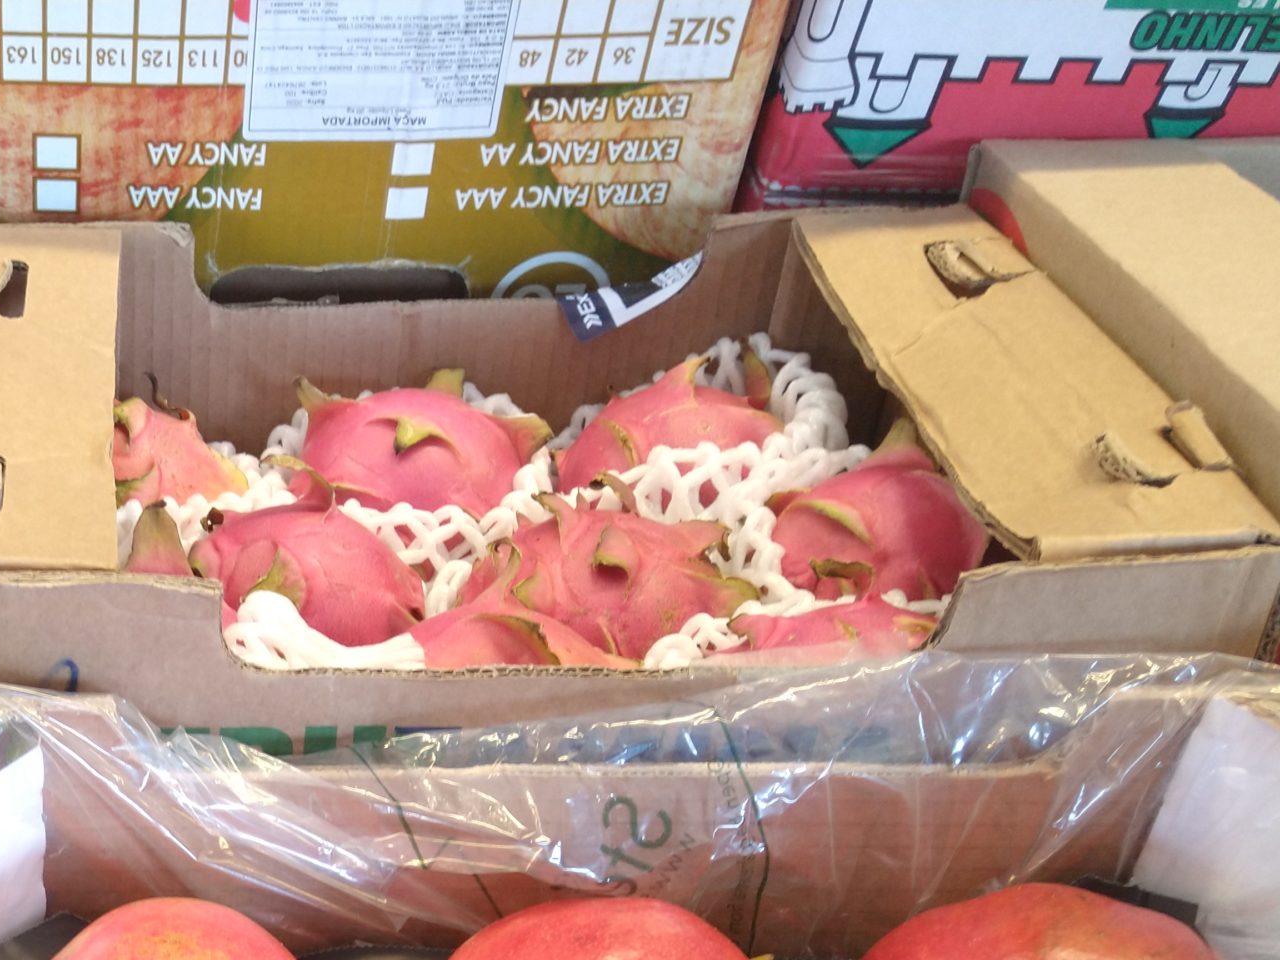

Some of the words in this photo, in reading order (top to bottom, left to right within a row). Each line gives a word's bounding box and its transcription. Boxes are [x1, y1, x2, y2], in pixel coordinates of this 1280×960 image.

[664, 16, 735, 46] SIZE
[7, 46, 37, 65] 163
[51, 47, 81, 66] 150
[96, 48, 126, 67] 138
[142, 49, 172, 68] 125
[188, 49, 219, 68] 113
[519, 48, 542, 67] 48
[565, 47, 588, 66] 42
[613, 46, 637, 65] 36
[525, 97, 607, 123] FANCY
[616, 94, 690, 120] EXTRA
[321, 115, 391, 127] IMPORTADA
[147, 142, 182, 166] AA
[188, 143, 267, 167] FANCY
[480, 143, 516, 167] AA
[519, 140, 600, 165] FANCY
[607, 138, 682, 163] EXTRA
[128, 185, 180, 210] AAA
[185, 187, 263, 211] FANCY
[455, 187, 507, 211] AAA
[511, 184, 590, 209] FANCY
[597, 182, 669, 206] EXTRA
